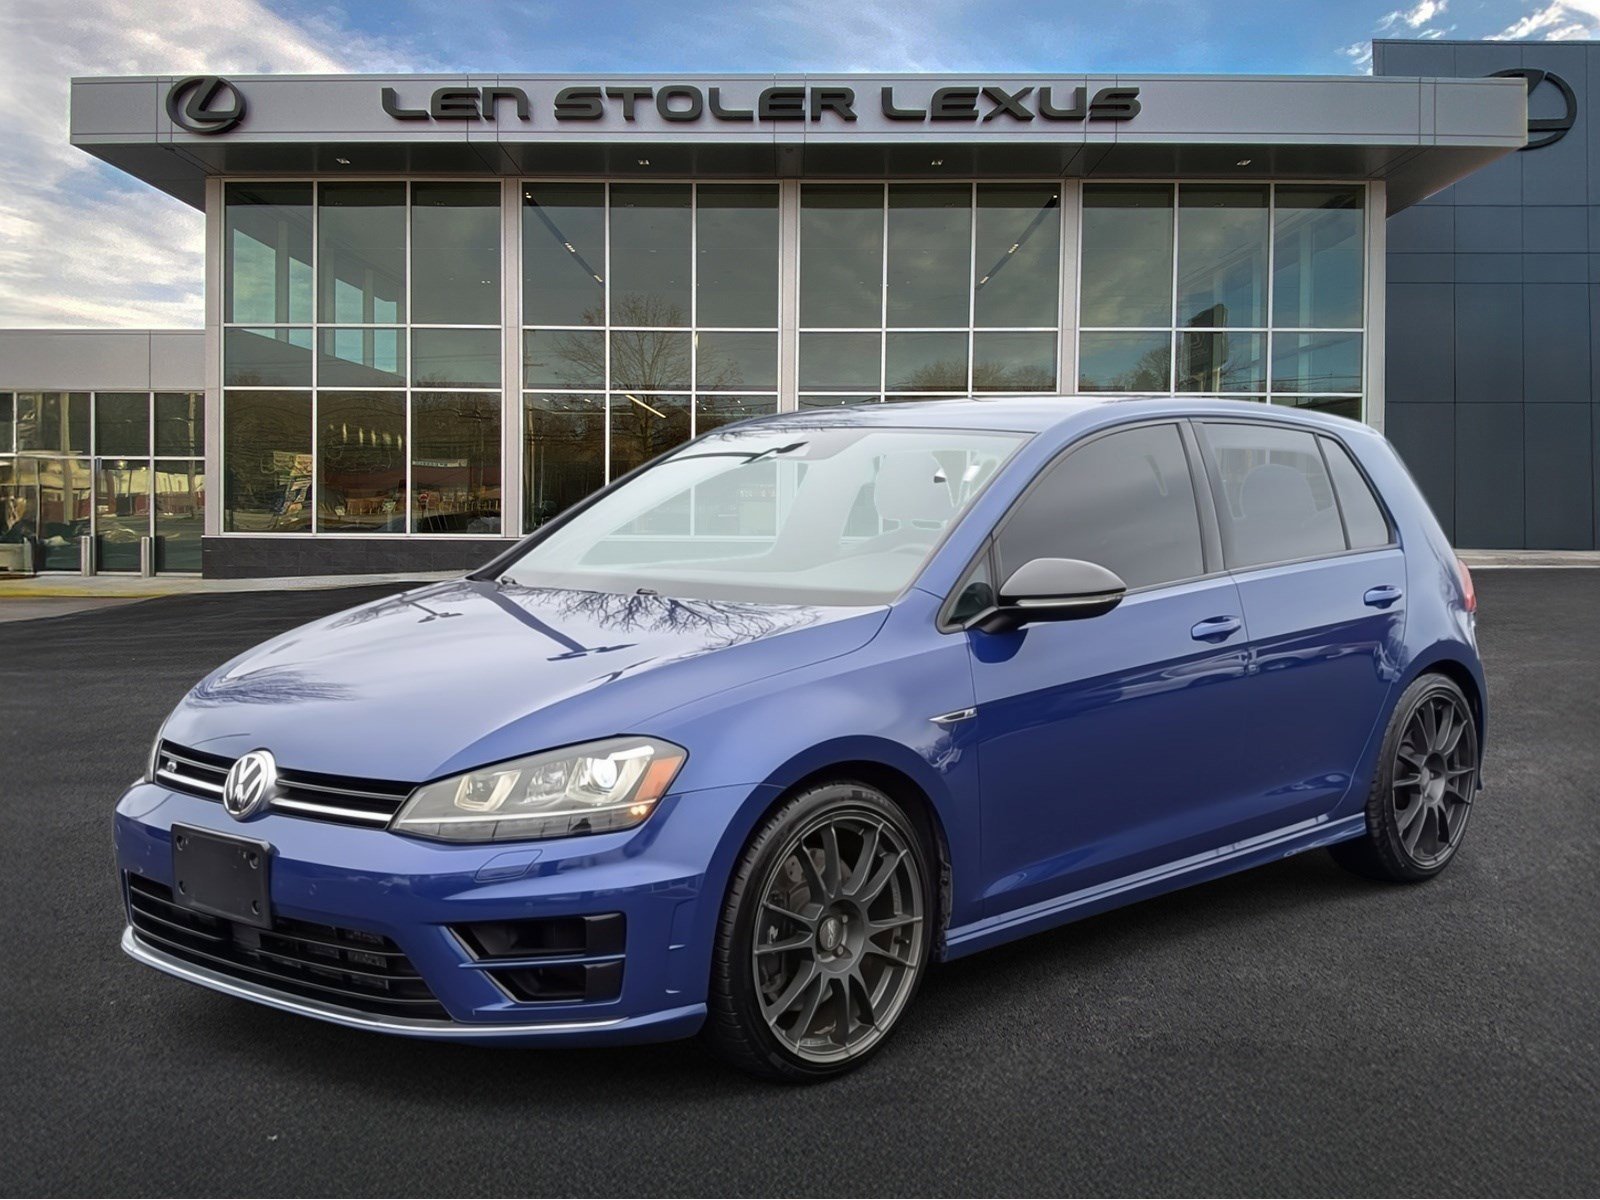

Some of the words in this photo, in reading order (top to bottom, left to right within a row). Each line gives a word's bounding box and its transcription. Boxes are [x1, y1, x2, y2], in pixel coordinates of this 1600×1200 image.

[381, 87, 531, 121] LEN
[554, 85, 857, 122] STOLER
[881, 86, 1141, 121] LEXUS
